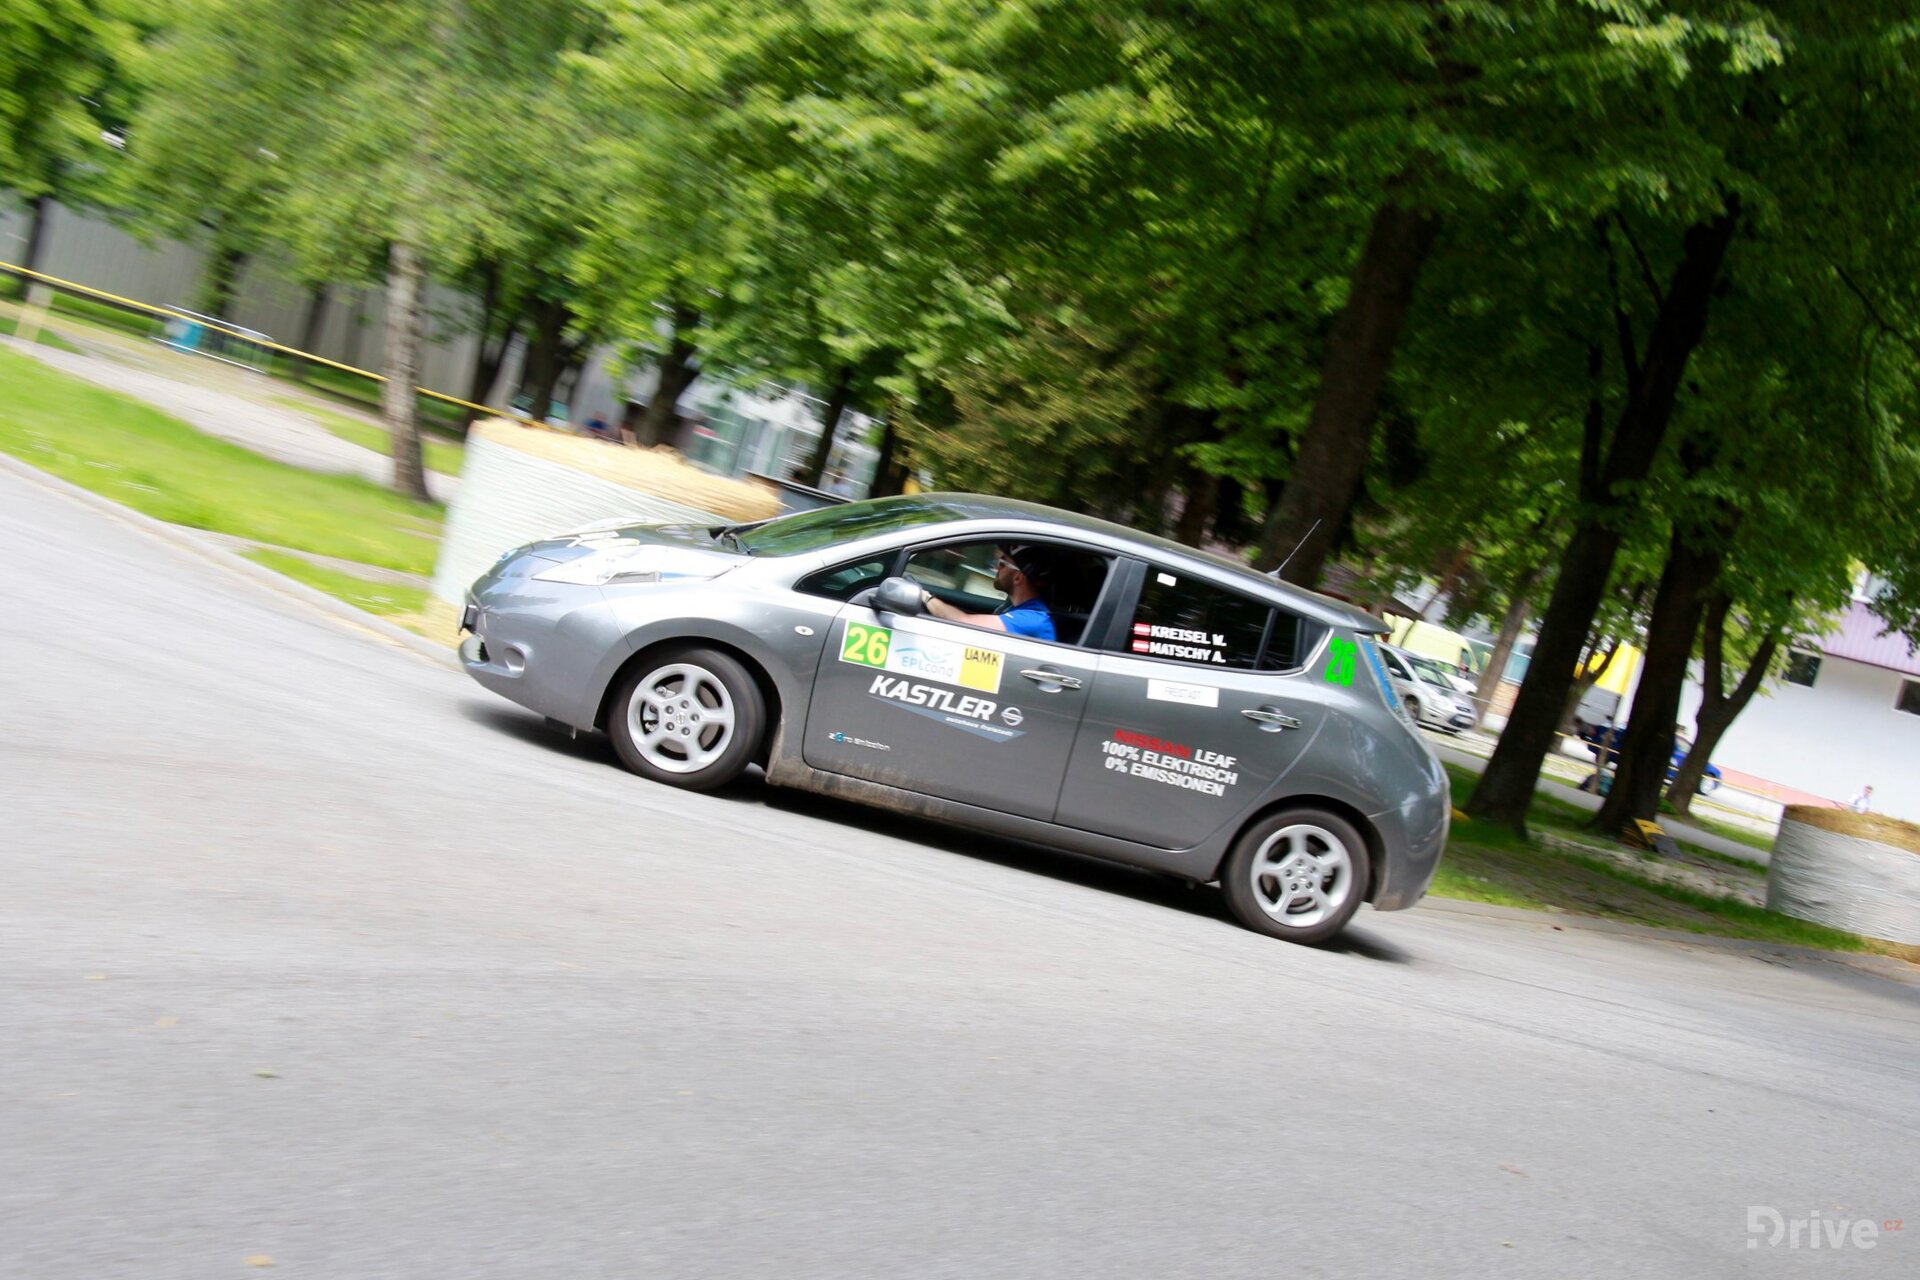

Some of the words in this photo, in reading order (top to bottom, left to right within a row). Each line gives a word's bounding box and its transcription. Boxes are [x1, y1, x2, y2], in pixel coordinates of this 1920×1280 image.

[844, 626, 890, 666] 26
[1149, 641, 1212, 661] MATSCHY
[1211, 650, 1226, 663] A.
[1151, 625, 1211, 644] KREISEL
[965, 648, 999, 666] UAMK
[1324, 637, 1357, 687] 26
[869, 675, 998, 721] KASTLER
[1101, 740, 1140, 761] 100%
[1142, 751, 1238, 785] ELEKTRISCH
[1113, 729, 1191, 759] NISSAN
[1194, 749, 1237, 769] LEAF
[1105, 756, 1128, 774] 0%
[1130, 764, 1226, 797] EMISSIONEN
